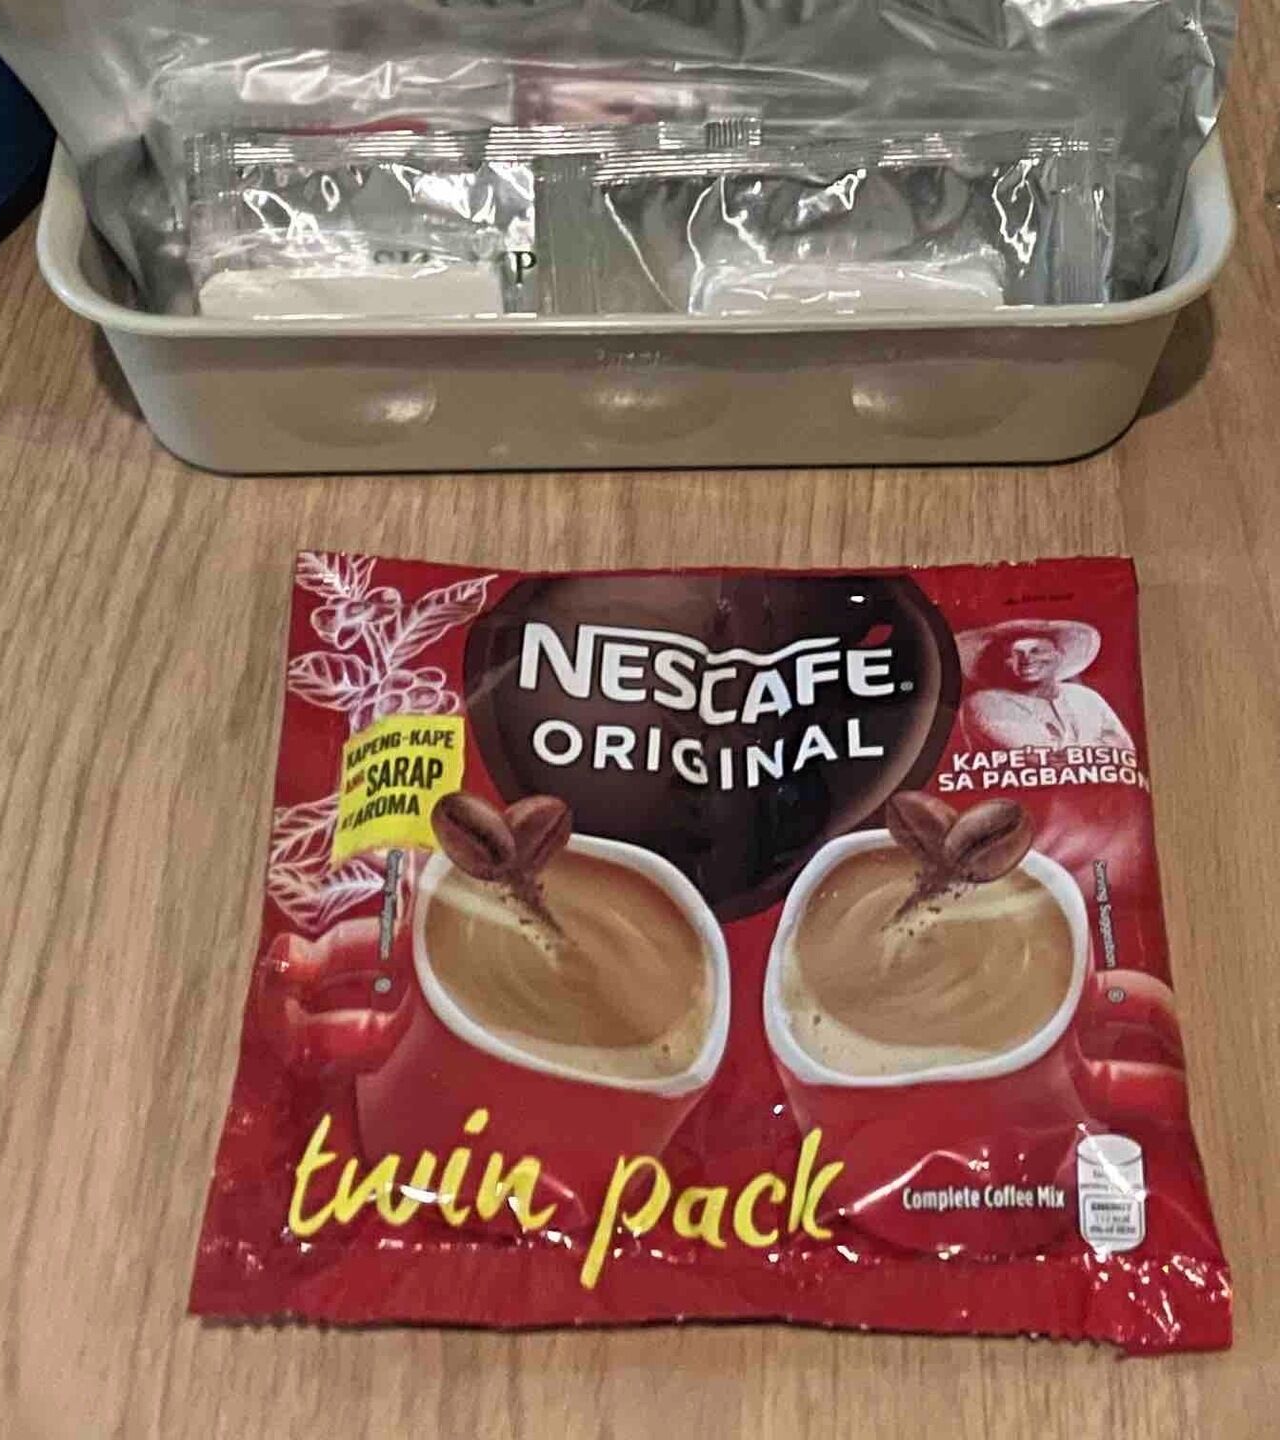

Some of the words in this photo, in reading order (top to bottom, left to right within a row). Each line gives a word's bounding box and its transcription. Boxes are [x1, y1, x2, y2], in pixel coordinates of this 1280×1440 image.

[346, 728, 456, 770] KAPENG-KAPE
[532, 718, 885, 790] ORIGINAL
[952, 745, 1051, 772] KAPE'T
[1066, 745, 1138, 768] BISIG
[365, 754, 444, 797] SARAP
[938, 770, 974, 792] SA
[982, 764, 1150, 793] PAGBANGON
[352, 793, 421, 830] AROMA
[1094, 860, 1109, 902] Serving
[1099, 903, 1116, 968] Suggestion
[287, 1107, 559, 1237] twin
[579, 1127, 846, 1290] pack
[902, 1185, 981, 1212] Complete
[983, 1184, 1034, 1209] Coffee
[1037, 1184, 1066, 1208] Mix
